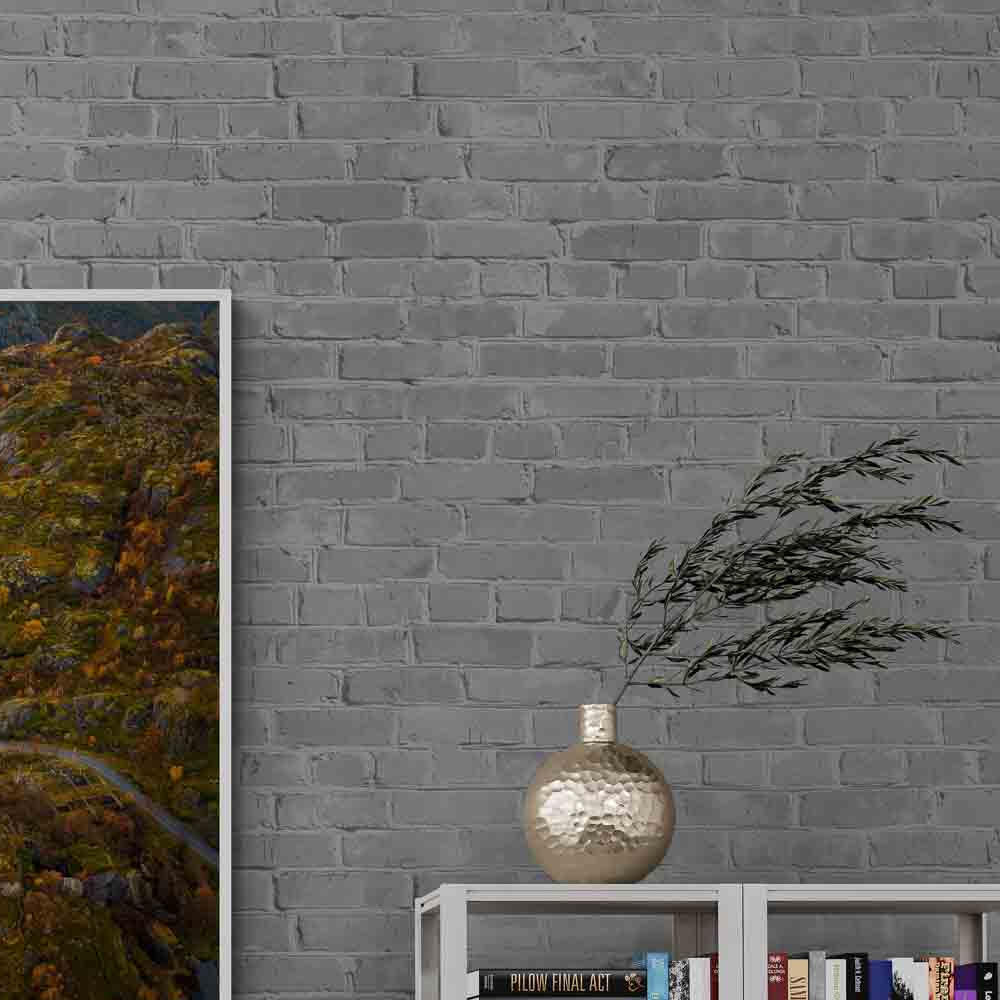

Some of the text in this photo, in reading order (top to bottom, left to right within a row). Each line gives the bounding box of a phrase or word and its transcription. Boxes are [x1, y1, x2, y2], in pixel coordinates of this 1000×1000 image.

[510, 973, 548, 992] PILOW
[552, 973, 585, 992] FINAL
[589, 973, 611, 992] ACT
